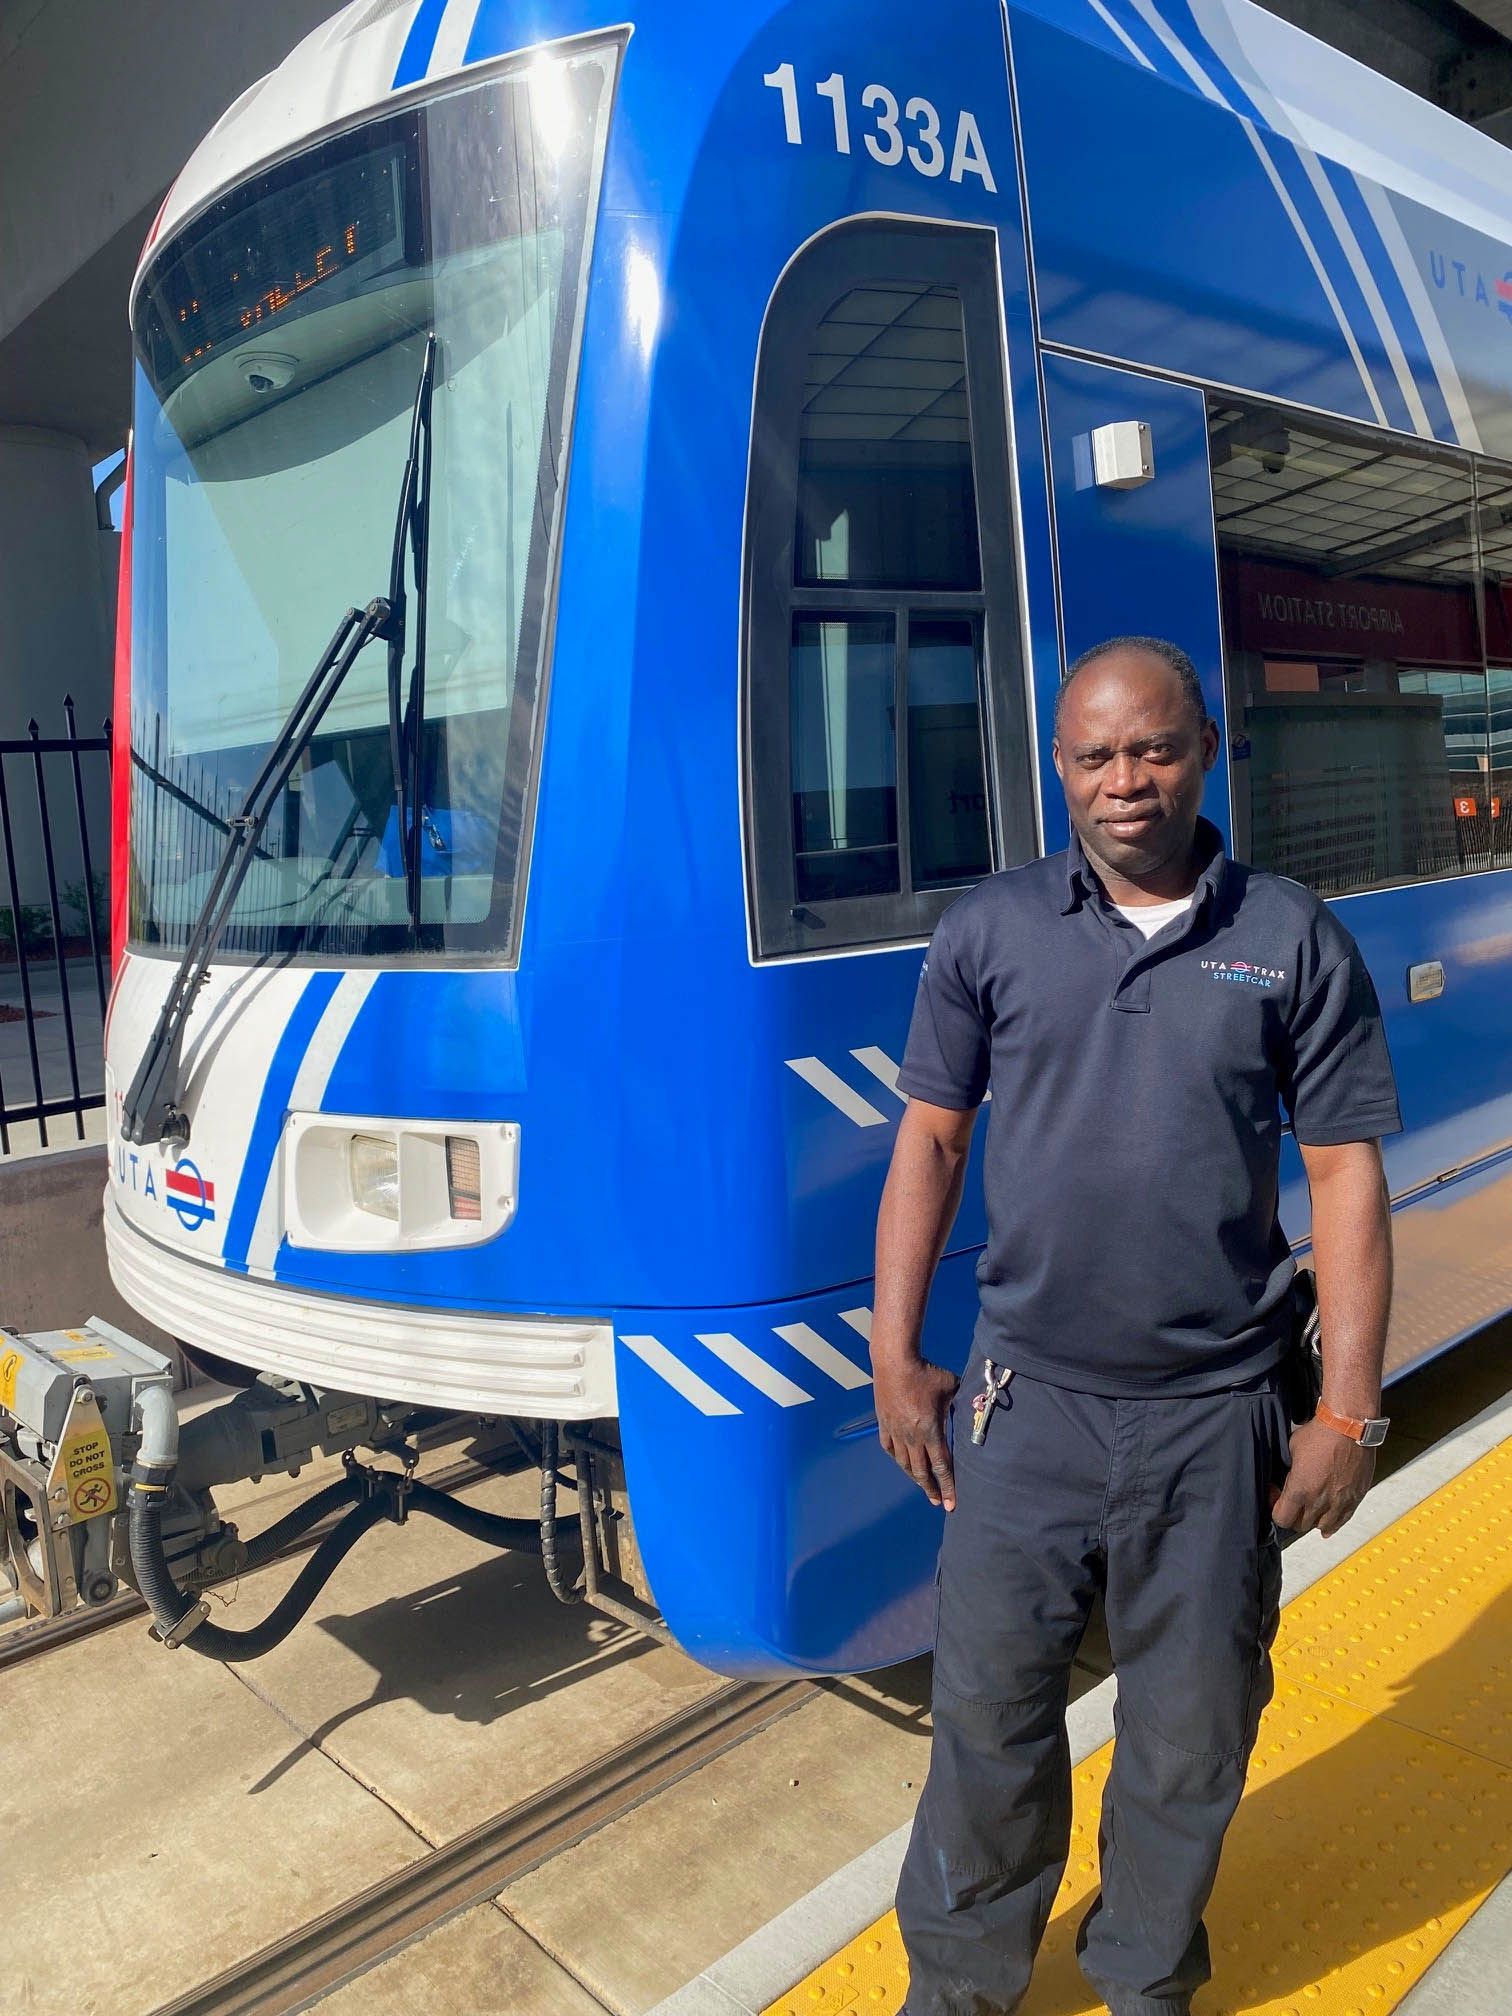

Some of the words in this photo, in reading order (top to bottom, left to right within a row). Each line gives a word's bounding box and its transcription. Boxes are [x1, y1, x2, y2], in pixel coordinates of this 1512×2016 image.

[763, 62, 998, 193] 1133A
[1430, 250, 1489, 307] UTA
[1201, 960, 1227, 970] UTA
[1253, 965, 1285, 980] TRAX
[1213, 971, 1271, 988] STREETCAR
[118, 1145, 157, 1201] UTA
[73, 1441, 99, 1455] STOP
[69, 1458, 83, 1468] DO
[85, 1450, 105, 1463] NOT
[72, 1462, 105, 1478] CROSS
